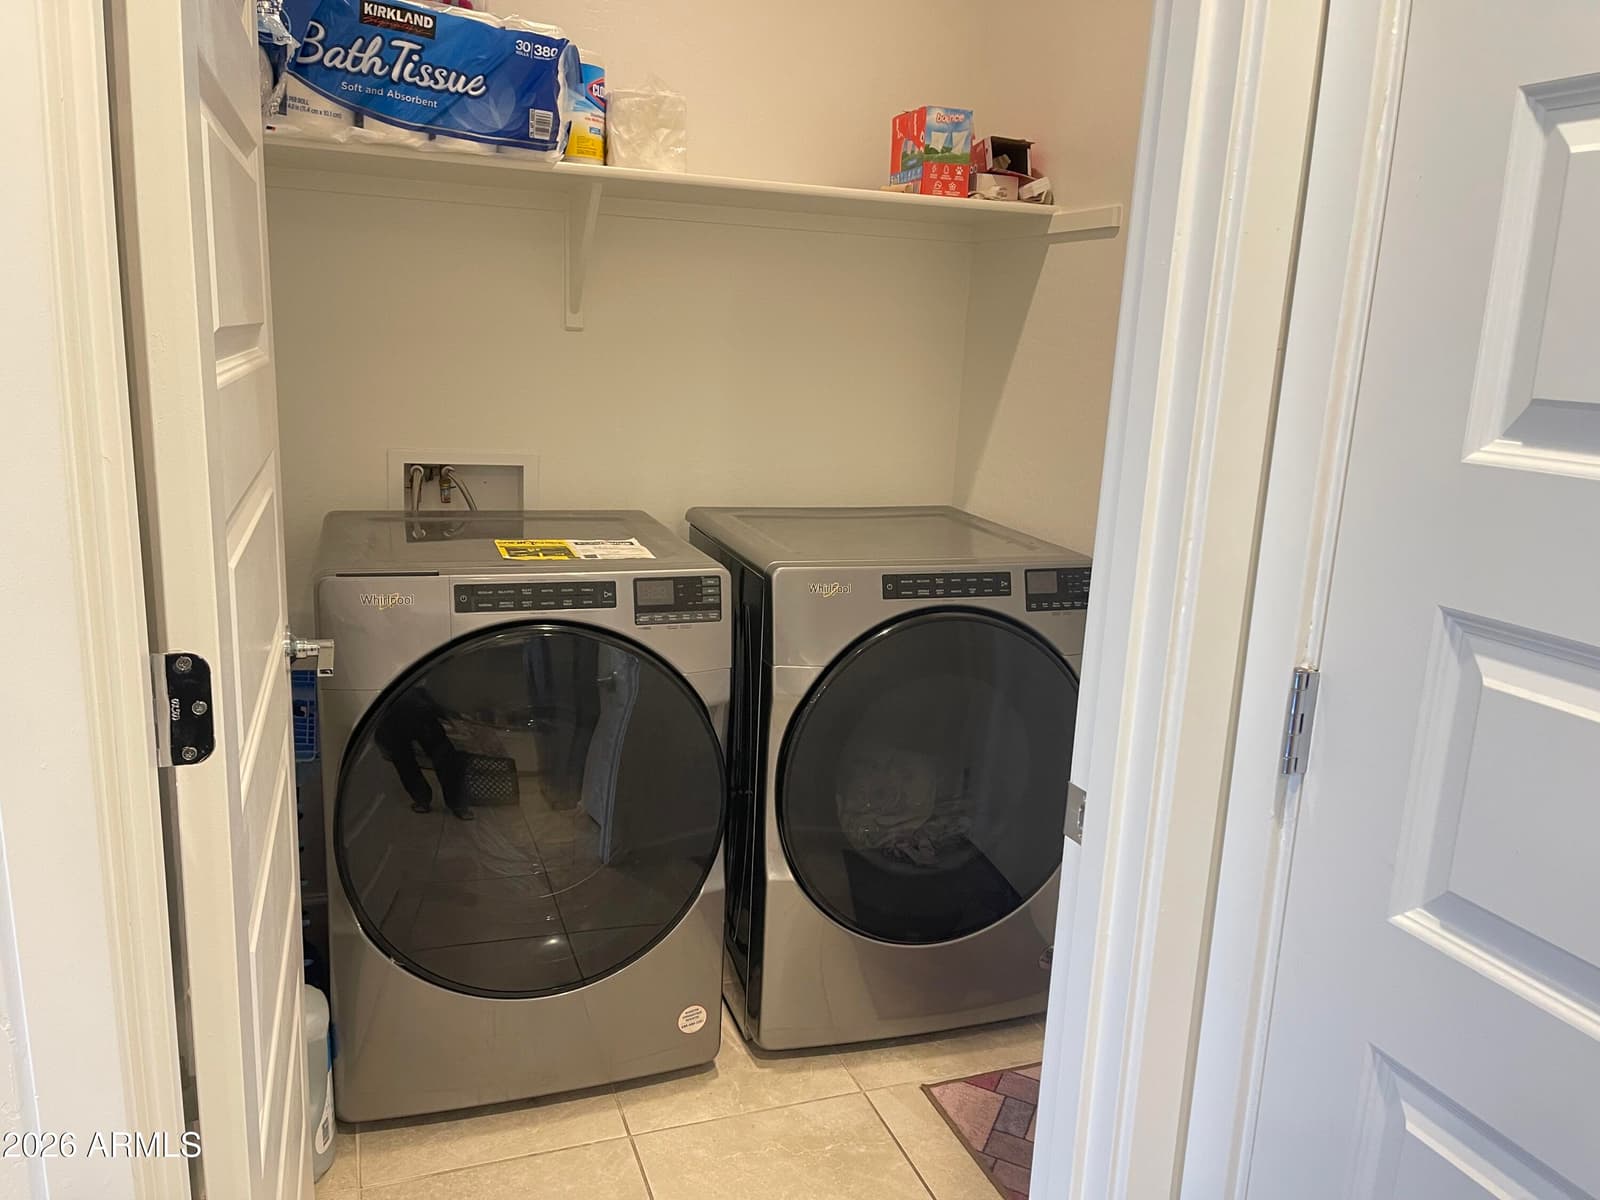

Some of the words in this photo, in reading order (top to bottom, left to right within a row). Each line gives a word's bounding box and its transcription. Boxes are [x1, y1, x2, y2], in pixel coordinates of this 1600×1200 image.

[364, 2, 434, 29] KIRKLAND
[296, 20, 389, 76] Bath
[390, 39, 487, 96] Tissue
[515, 39, 531, 53] 30
[533, 44, 559, 58] 380
[340, 81, 363, 93] Soft
[365, 85, 384, 96] and
[386, 88, 438, 109] Absorbent
